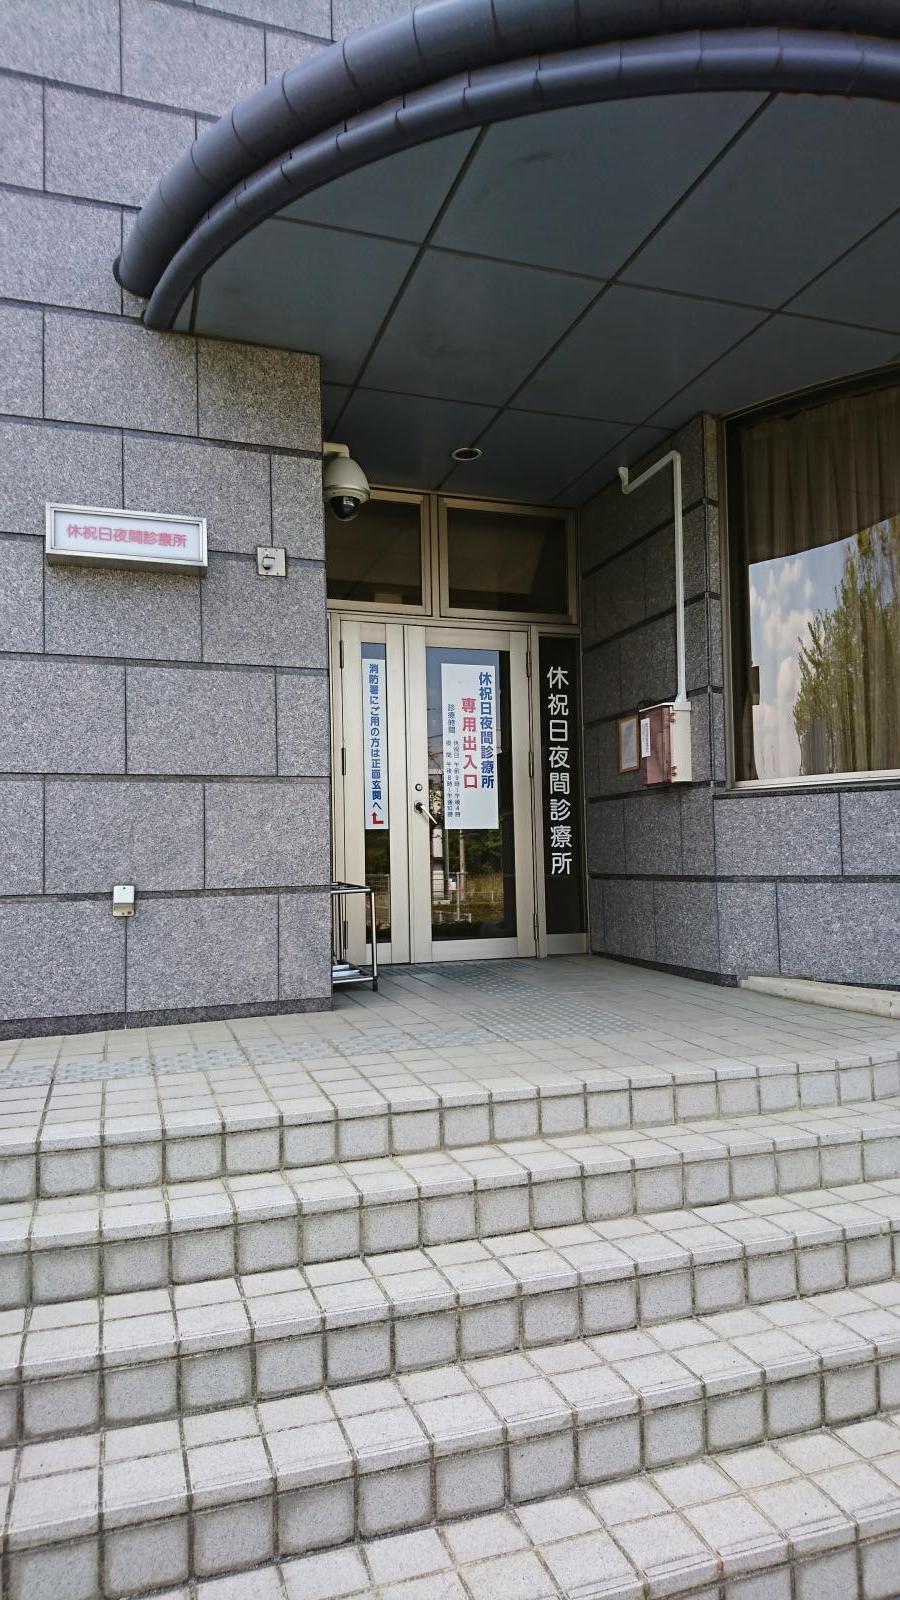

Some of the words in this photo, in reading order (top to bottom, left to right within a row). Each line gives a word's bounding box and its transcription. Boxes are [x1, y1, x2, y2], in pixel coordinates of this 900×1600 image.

[66, 523, 188, 548] 休祝日夜間診療所
[368, 663, 382, 810] 消防署にご用の方は正面玄関へ
[461, 697, 478, 789] 専用出入口
[478, 671, 495, 789] 休祝日夜間診療所
[546, 666, 573, 875] 休祝日夜間診療所
